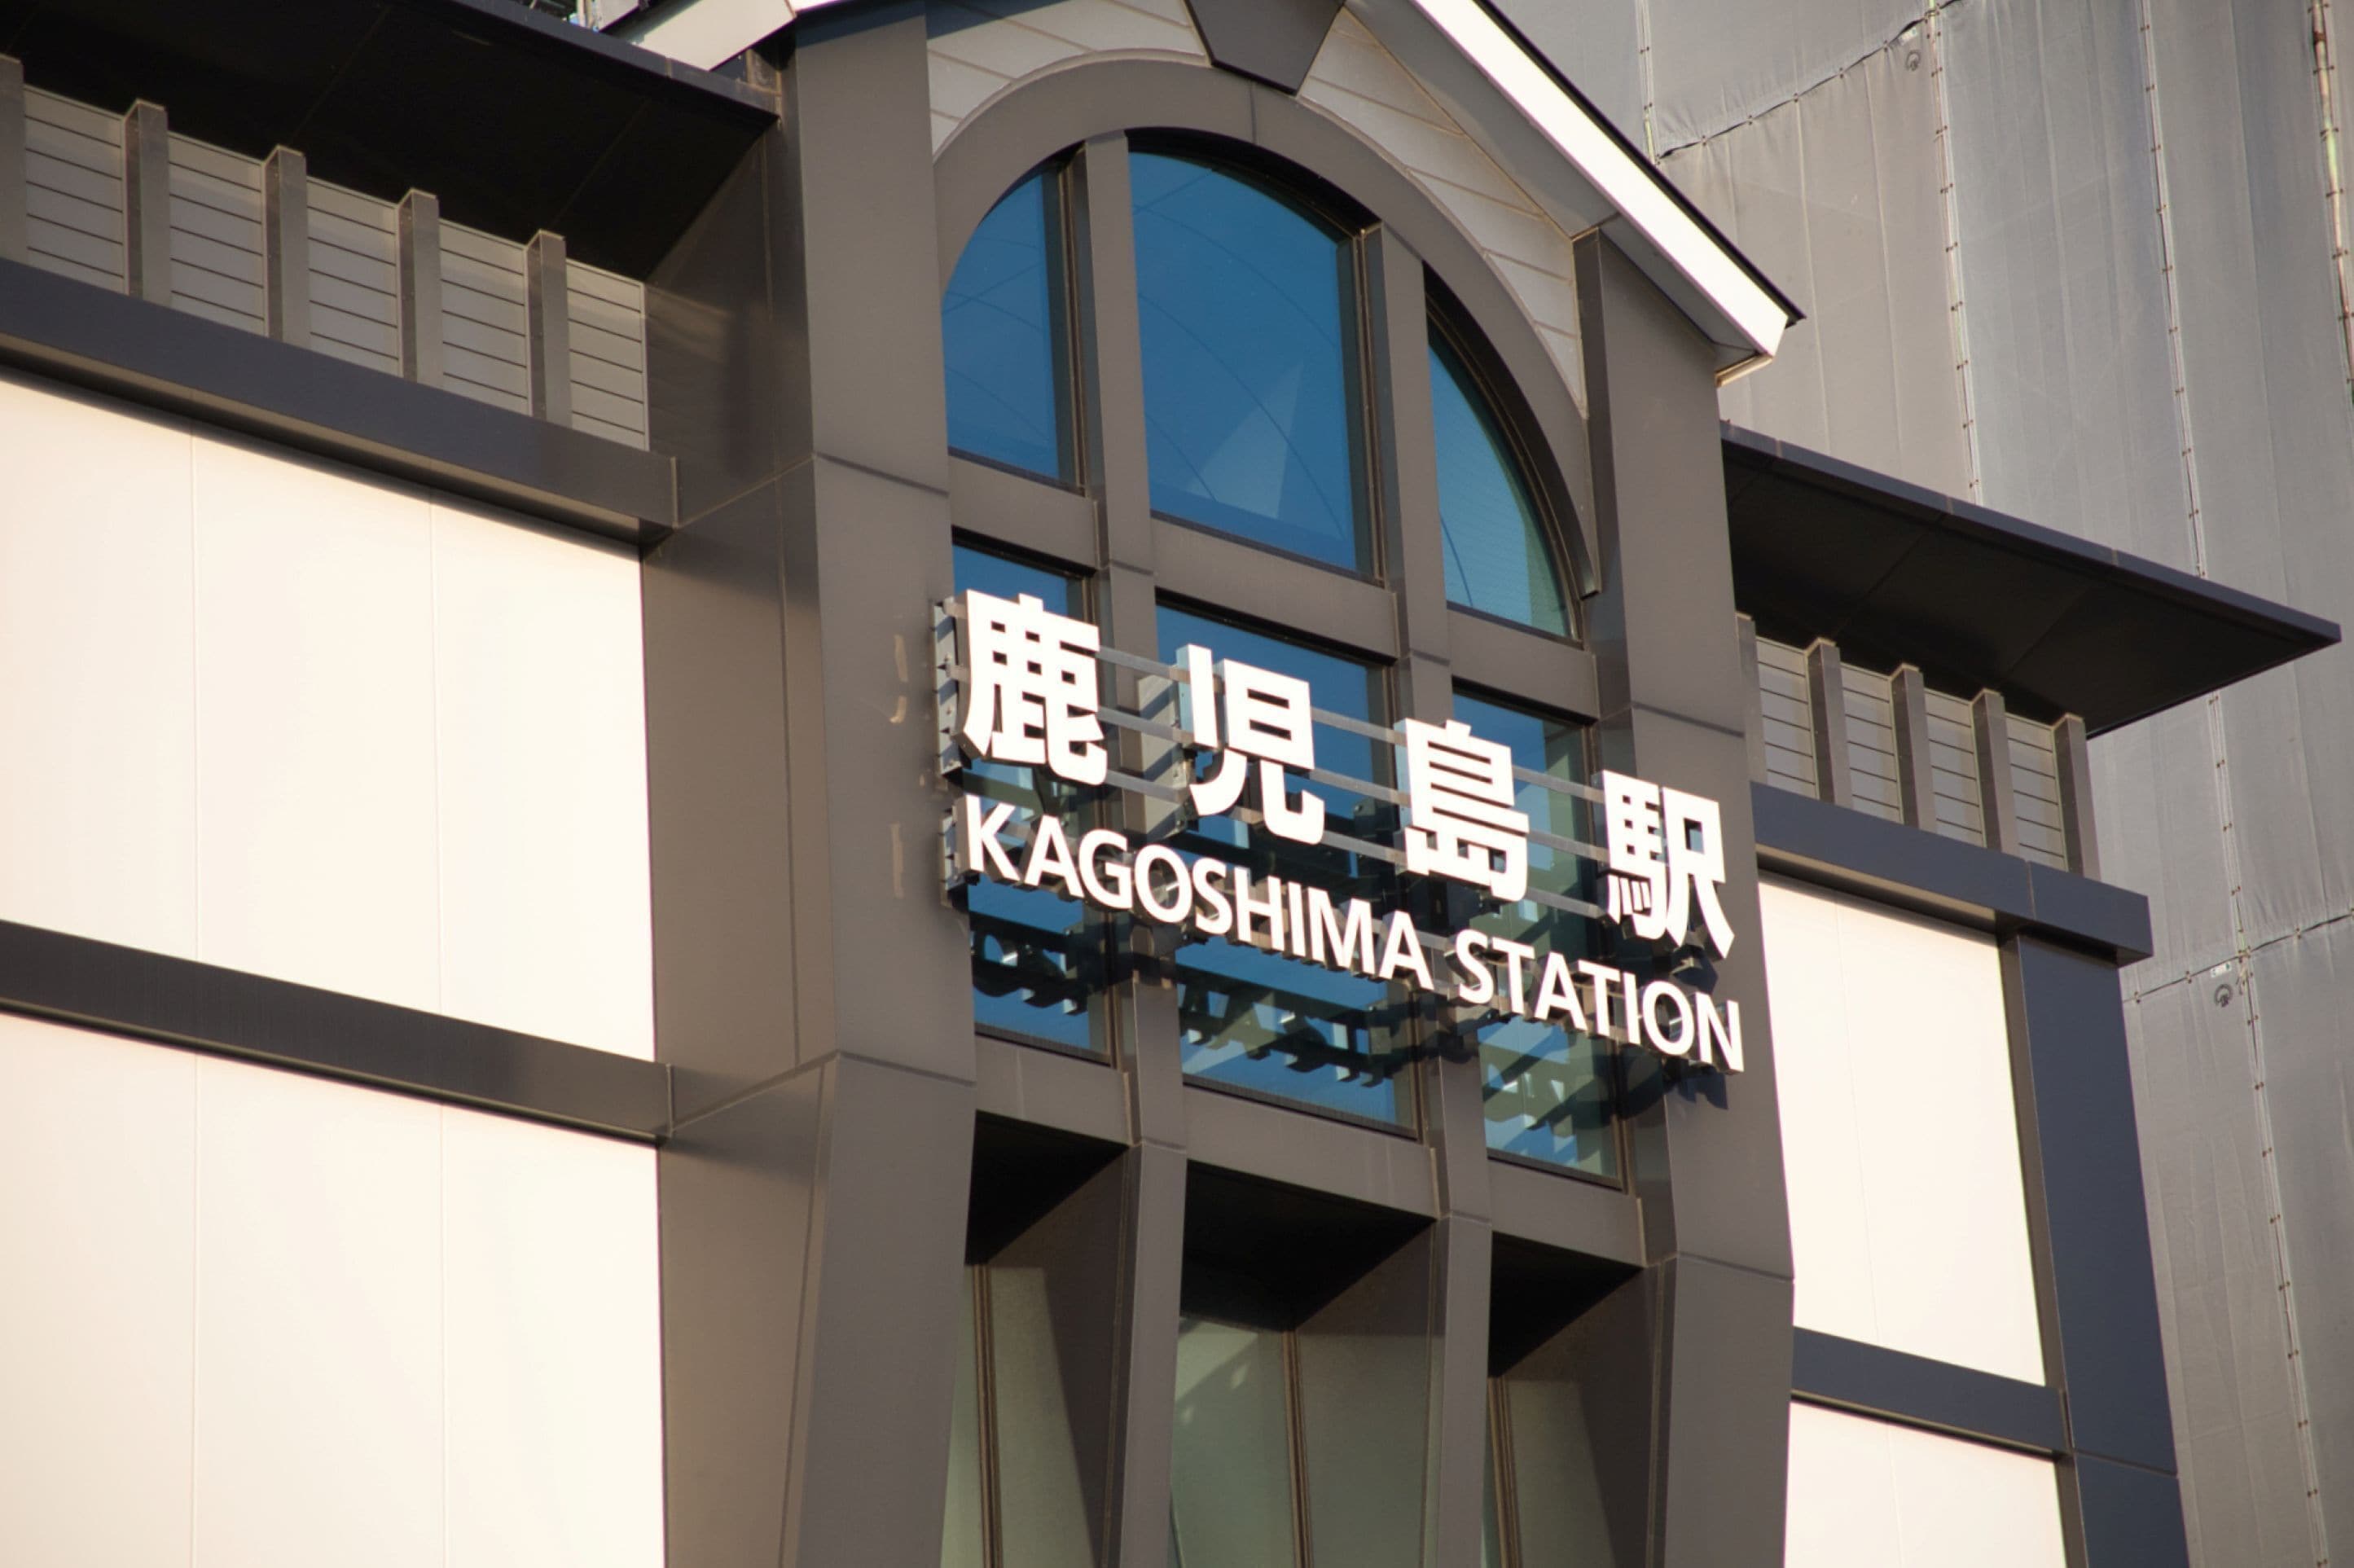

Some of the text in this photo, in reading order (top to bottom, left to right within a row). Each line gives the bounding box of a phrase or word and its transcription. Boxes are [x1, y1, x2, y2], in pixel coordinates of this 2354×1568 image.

[964, 590, 1736, 958] 鹿児島駅
[965, 794, 1744, 1071] KAGOSHIMA STATION
